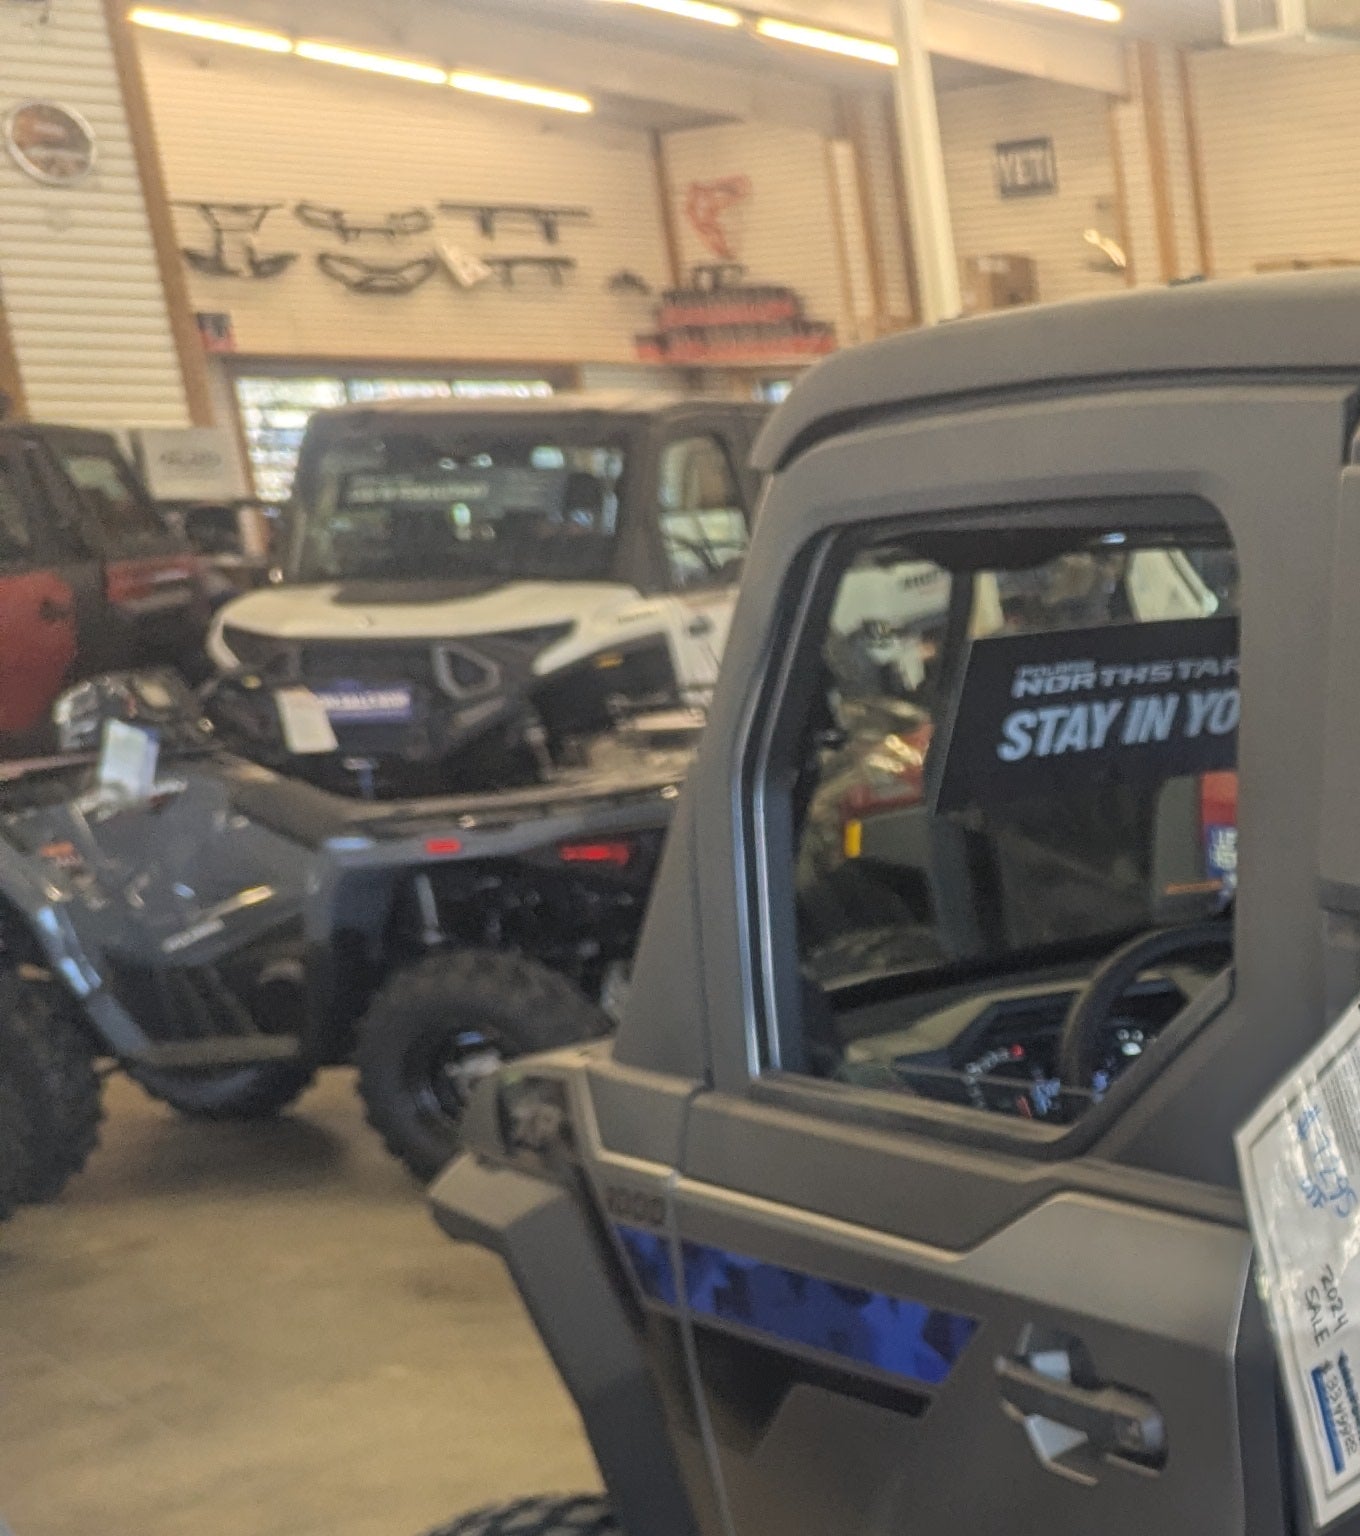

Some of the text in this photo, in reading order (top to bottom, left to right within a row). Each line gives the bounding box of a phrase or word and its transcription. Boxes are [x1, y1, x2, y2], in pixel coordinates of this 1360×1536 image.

[997, 699, 1123, 762] STAY
[1122, 691, 1180, 746] IN
[1303, 1285, 1330, 1348] SALE
[1320, 1262, 1350, 1334] 2024
